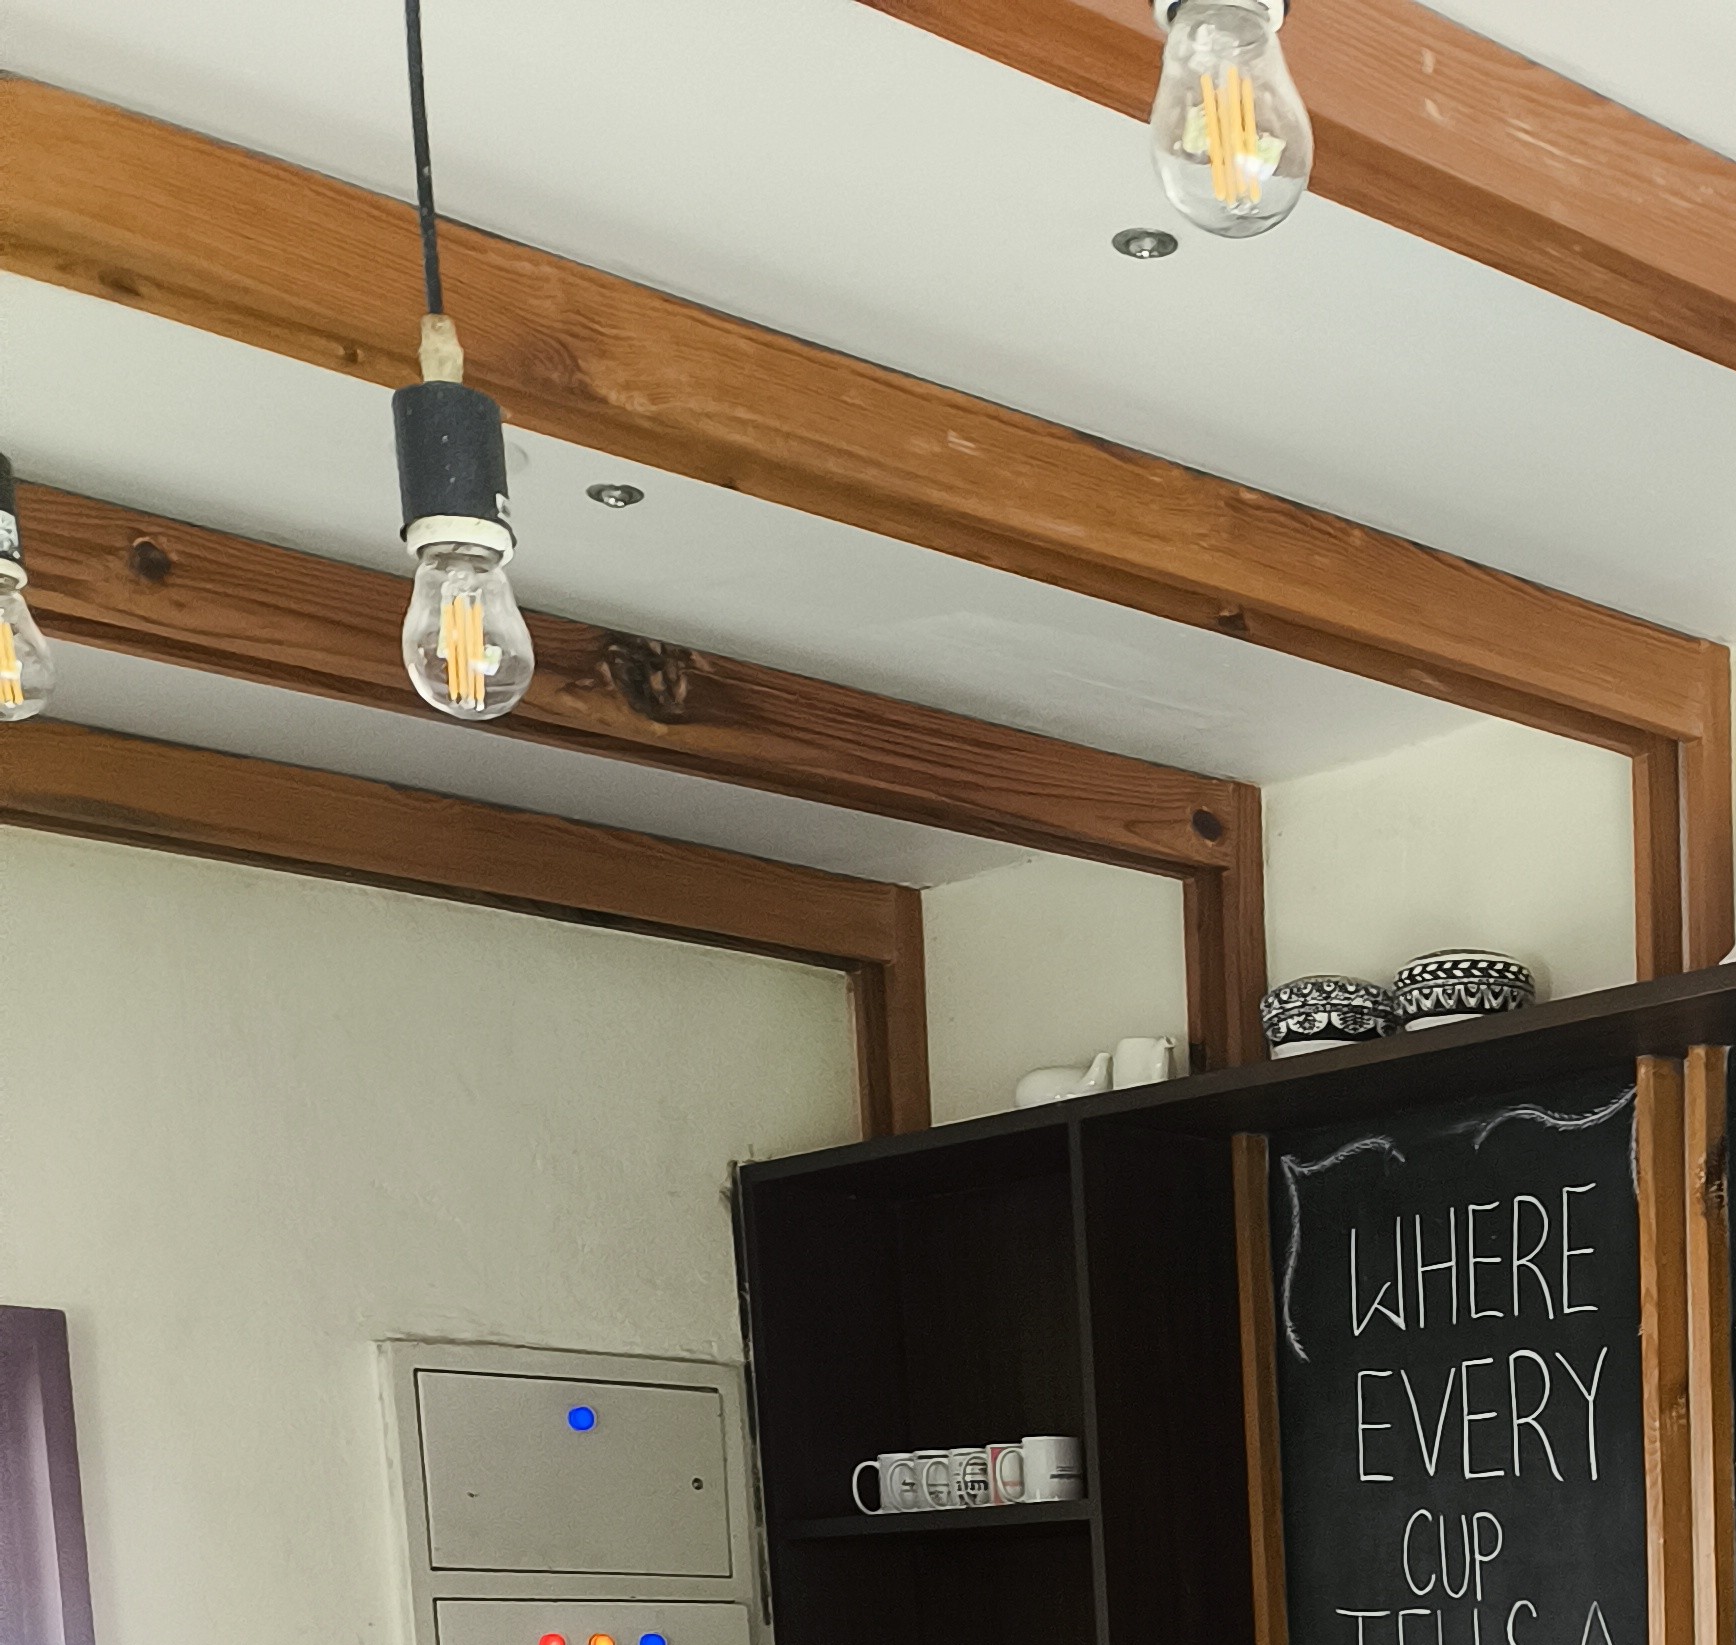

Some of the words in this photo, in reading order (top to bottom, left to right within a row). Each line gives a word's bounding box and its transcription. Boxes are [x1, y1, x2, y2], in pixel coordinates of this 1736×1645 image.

[1351, 1183, 1599, 1337] WHERE
[1358, 1347, 1607, 1482] EVERY
[1403, 1509, 1502, 1601] CUP
